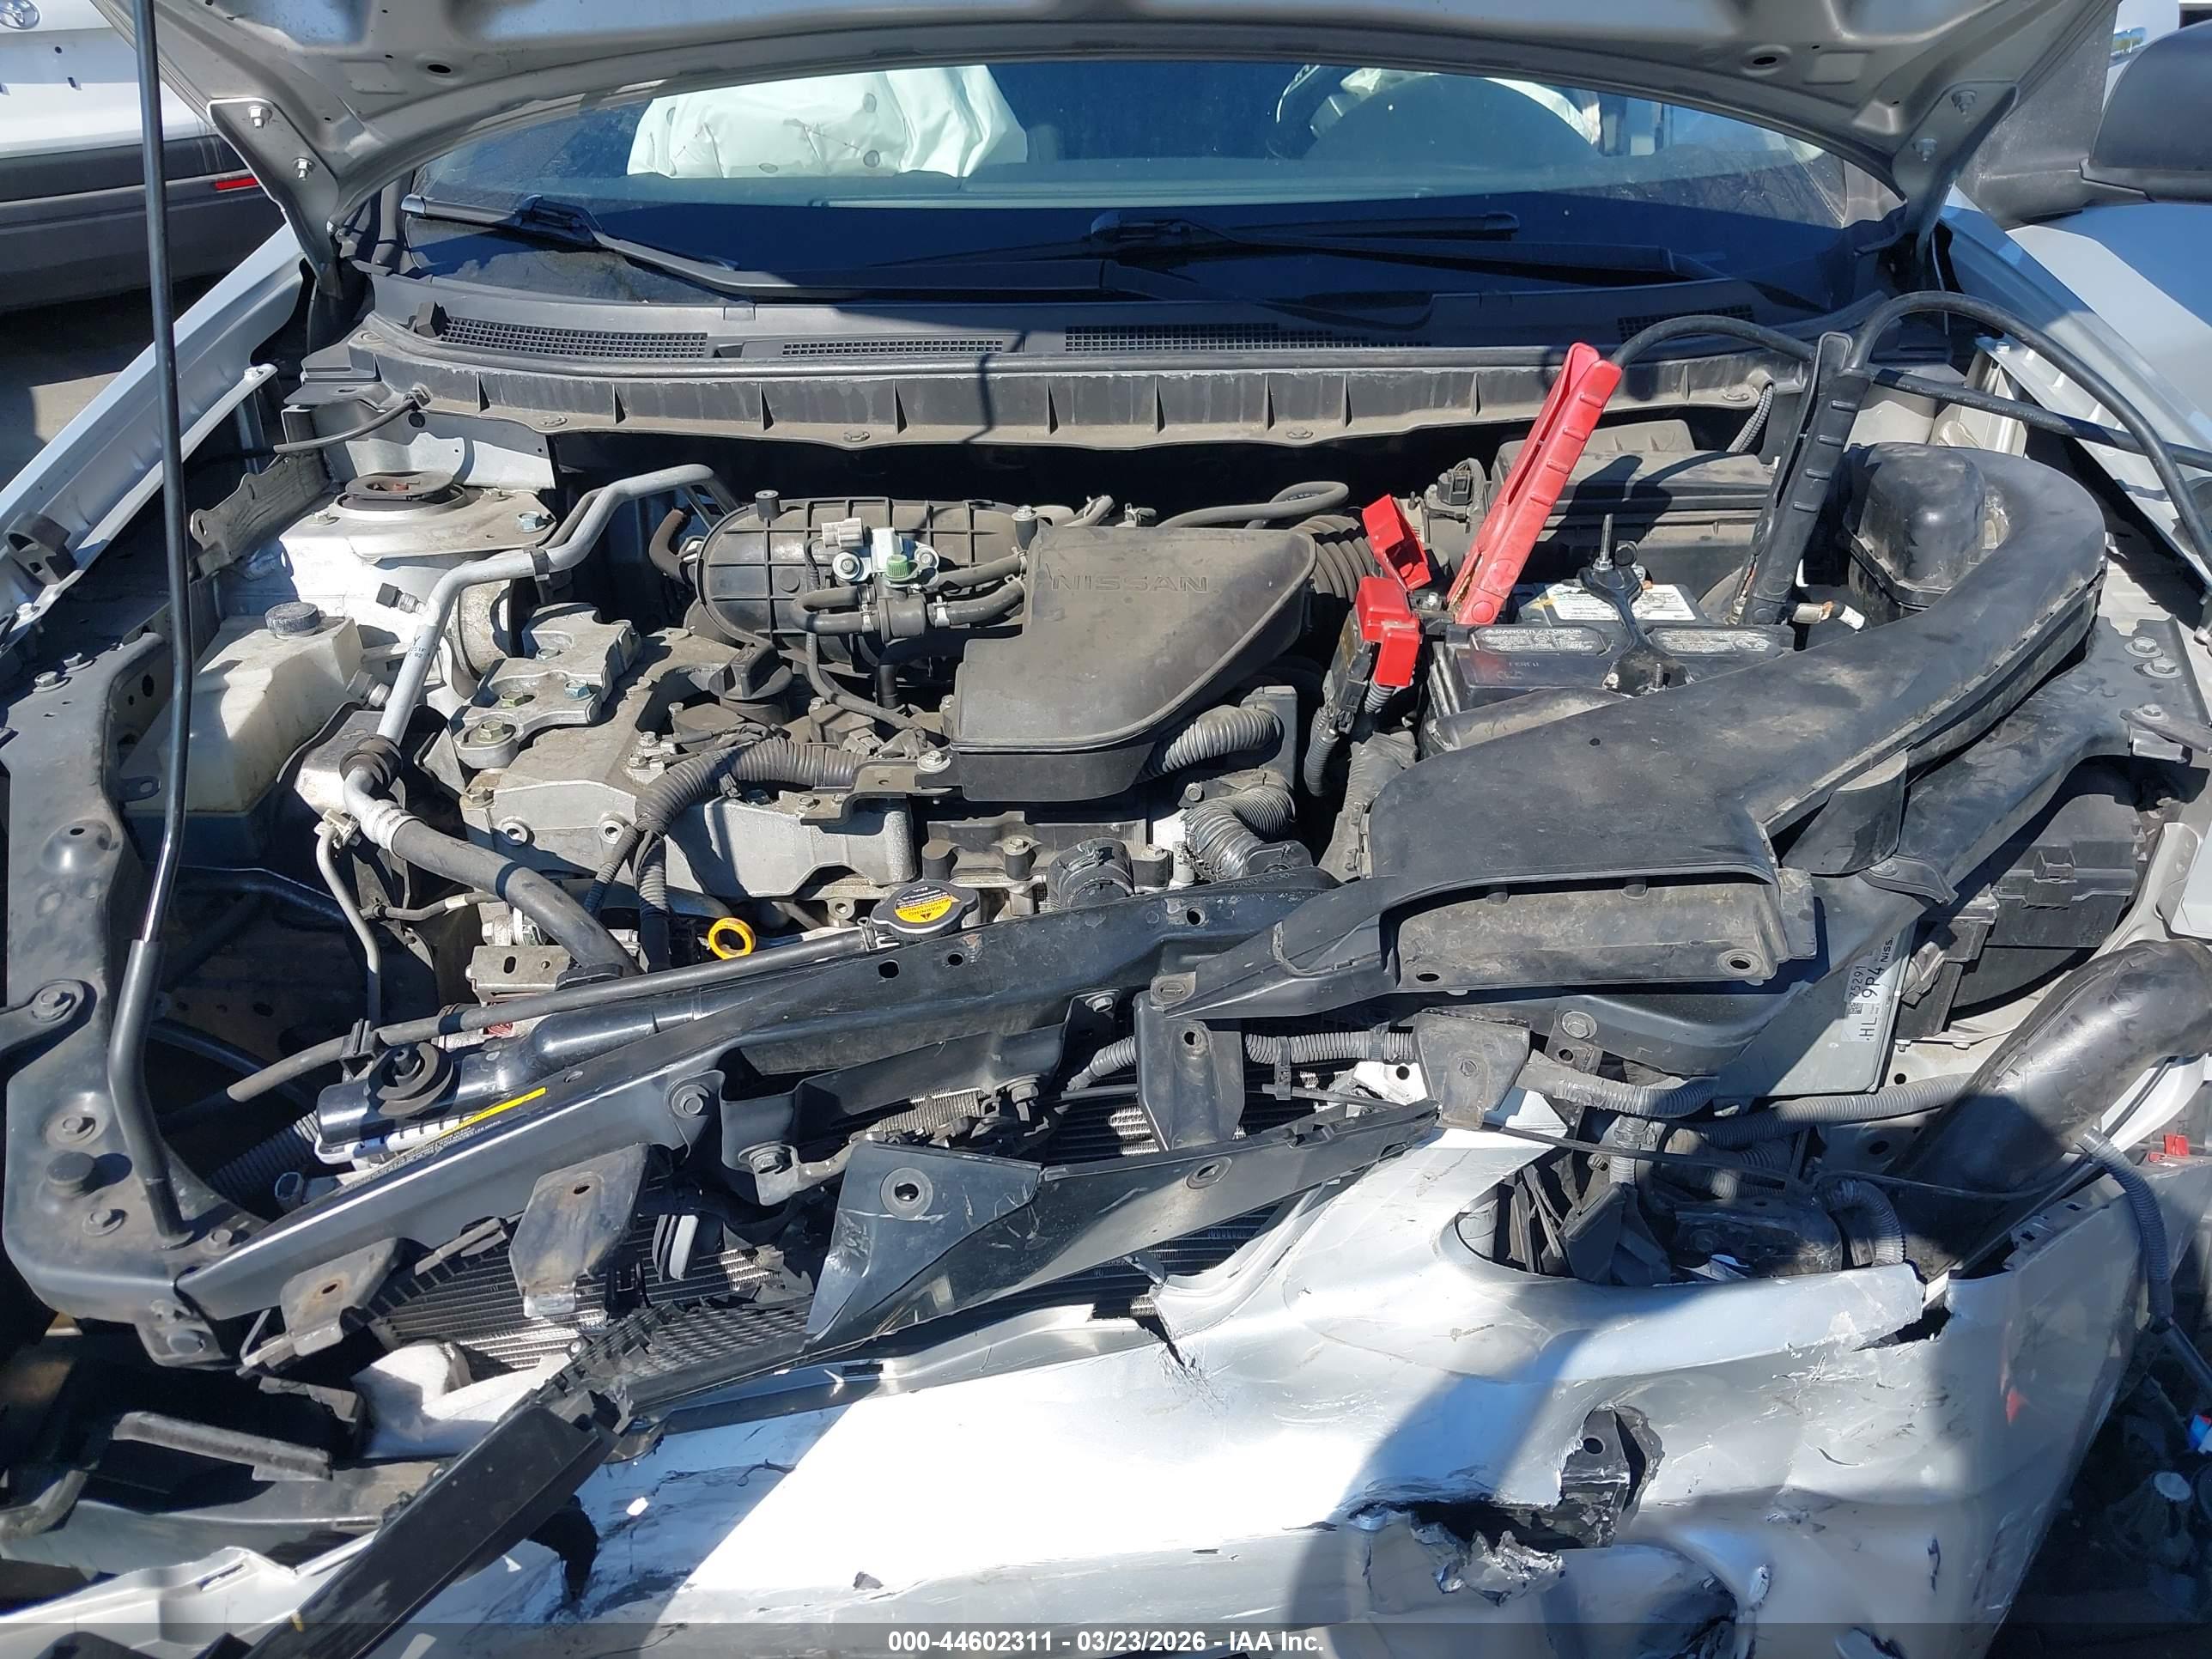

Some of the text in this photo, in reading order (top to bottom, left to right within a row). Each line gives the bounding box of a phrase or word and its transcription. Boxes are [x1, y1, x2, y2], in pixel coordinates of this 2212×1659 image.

[1052, 574, 1209, 592] NISSAN
[1849, 965, 1866, 998] 75291
[1862, 966, 1885, 998] 9P4
